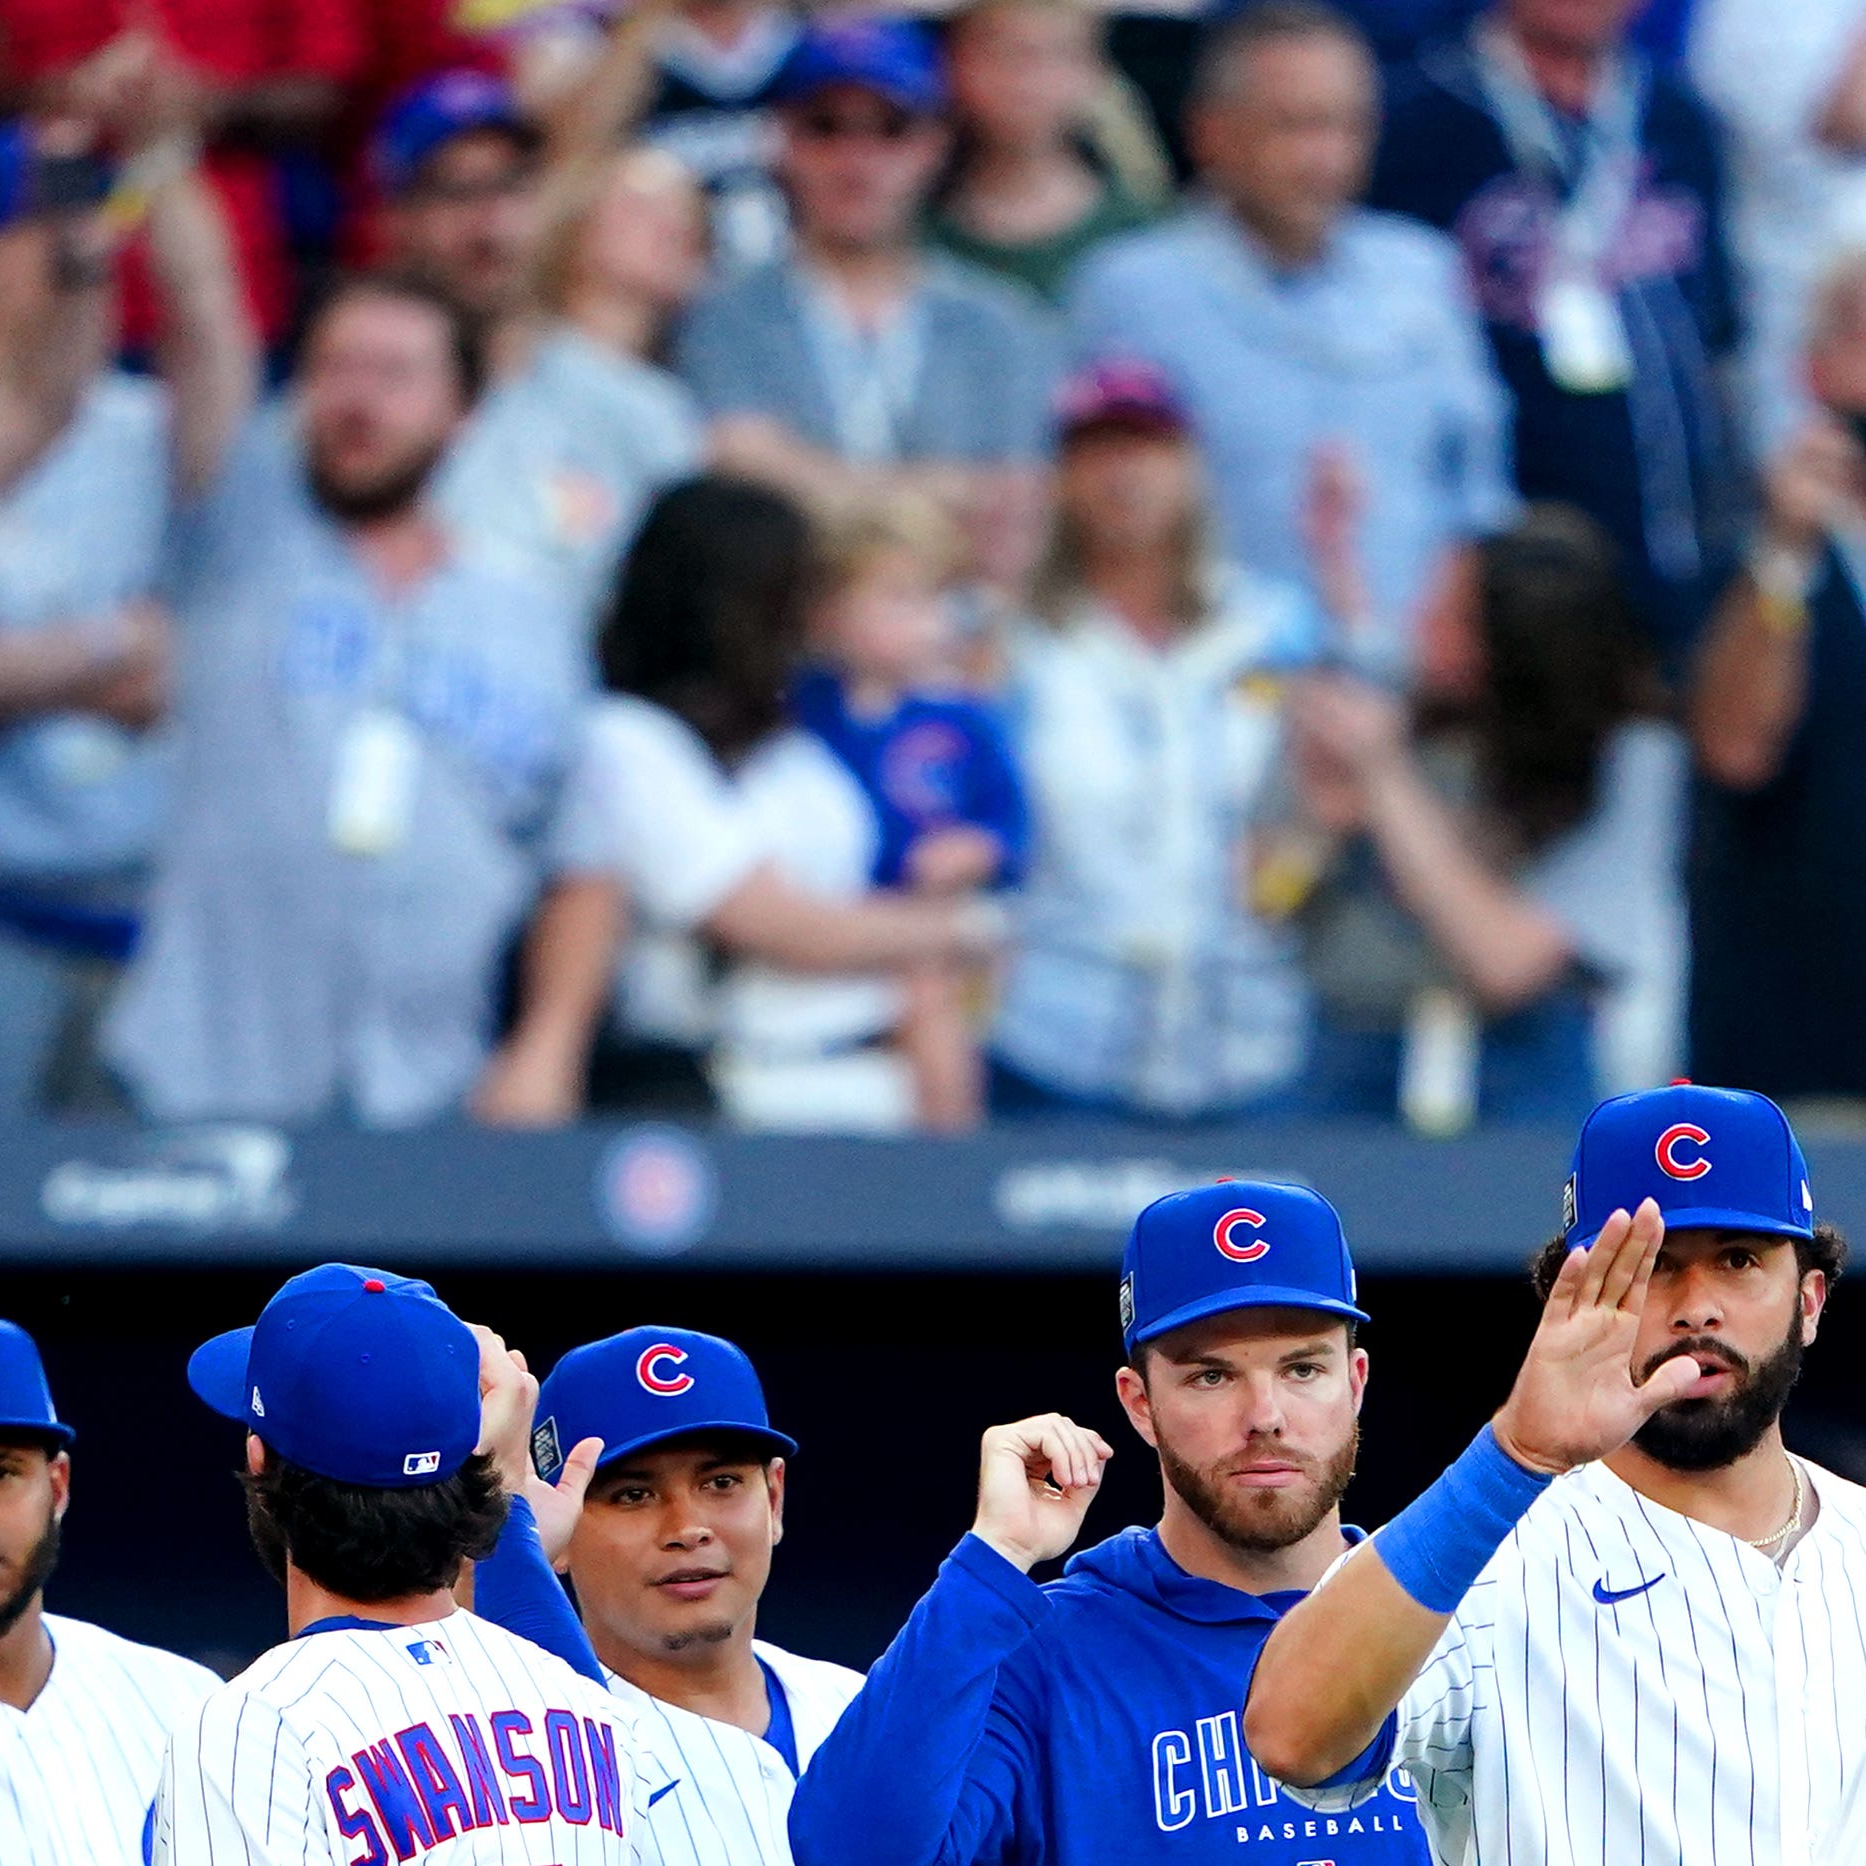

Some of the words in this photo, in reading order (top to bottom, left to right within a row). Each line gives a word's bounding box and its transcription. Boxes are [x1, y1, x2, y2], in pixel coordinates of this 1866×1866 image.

[1653, 1123, 1712, 1181] C
[1212, 1208, 1271, 1263] C
[635, 1342, 695, 1397] C
[1237, 1815, 1404, 1843] BASEBALL
